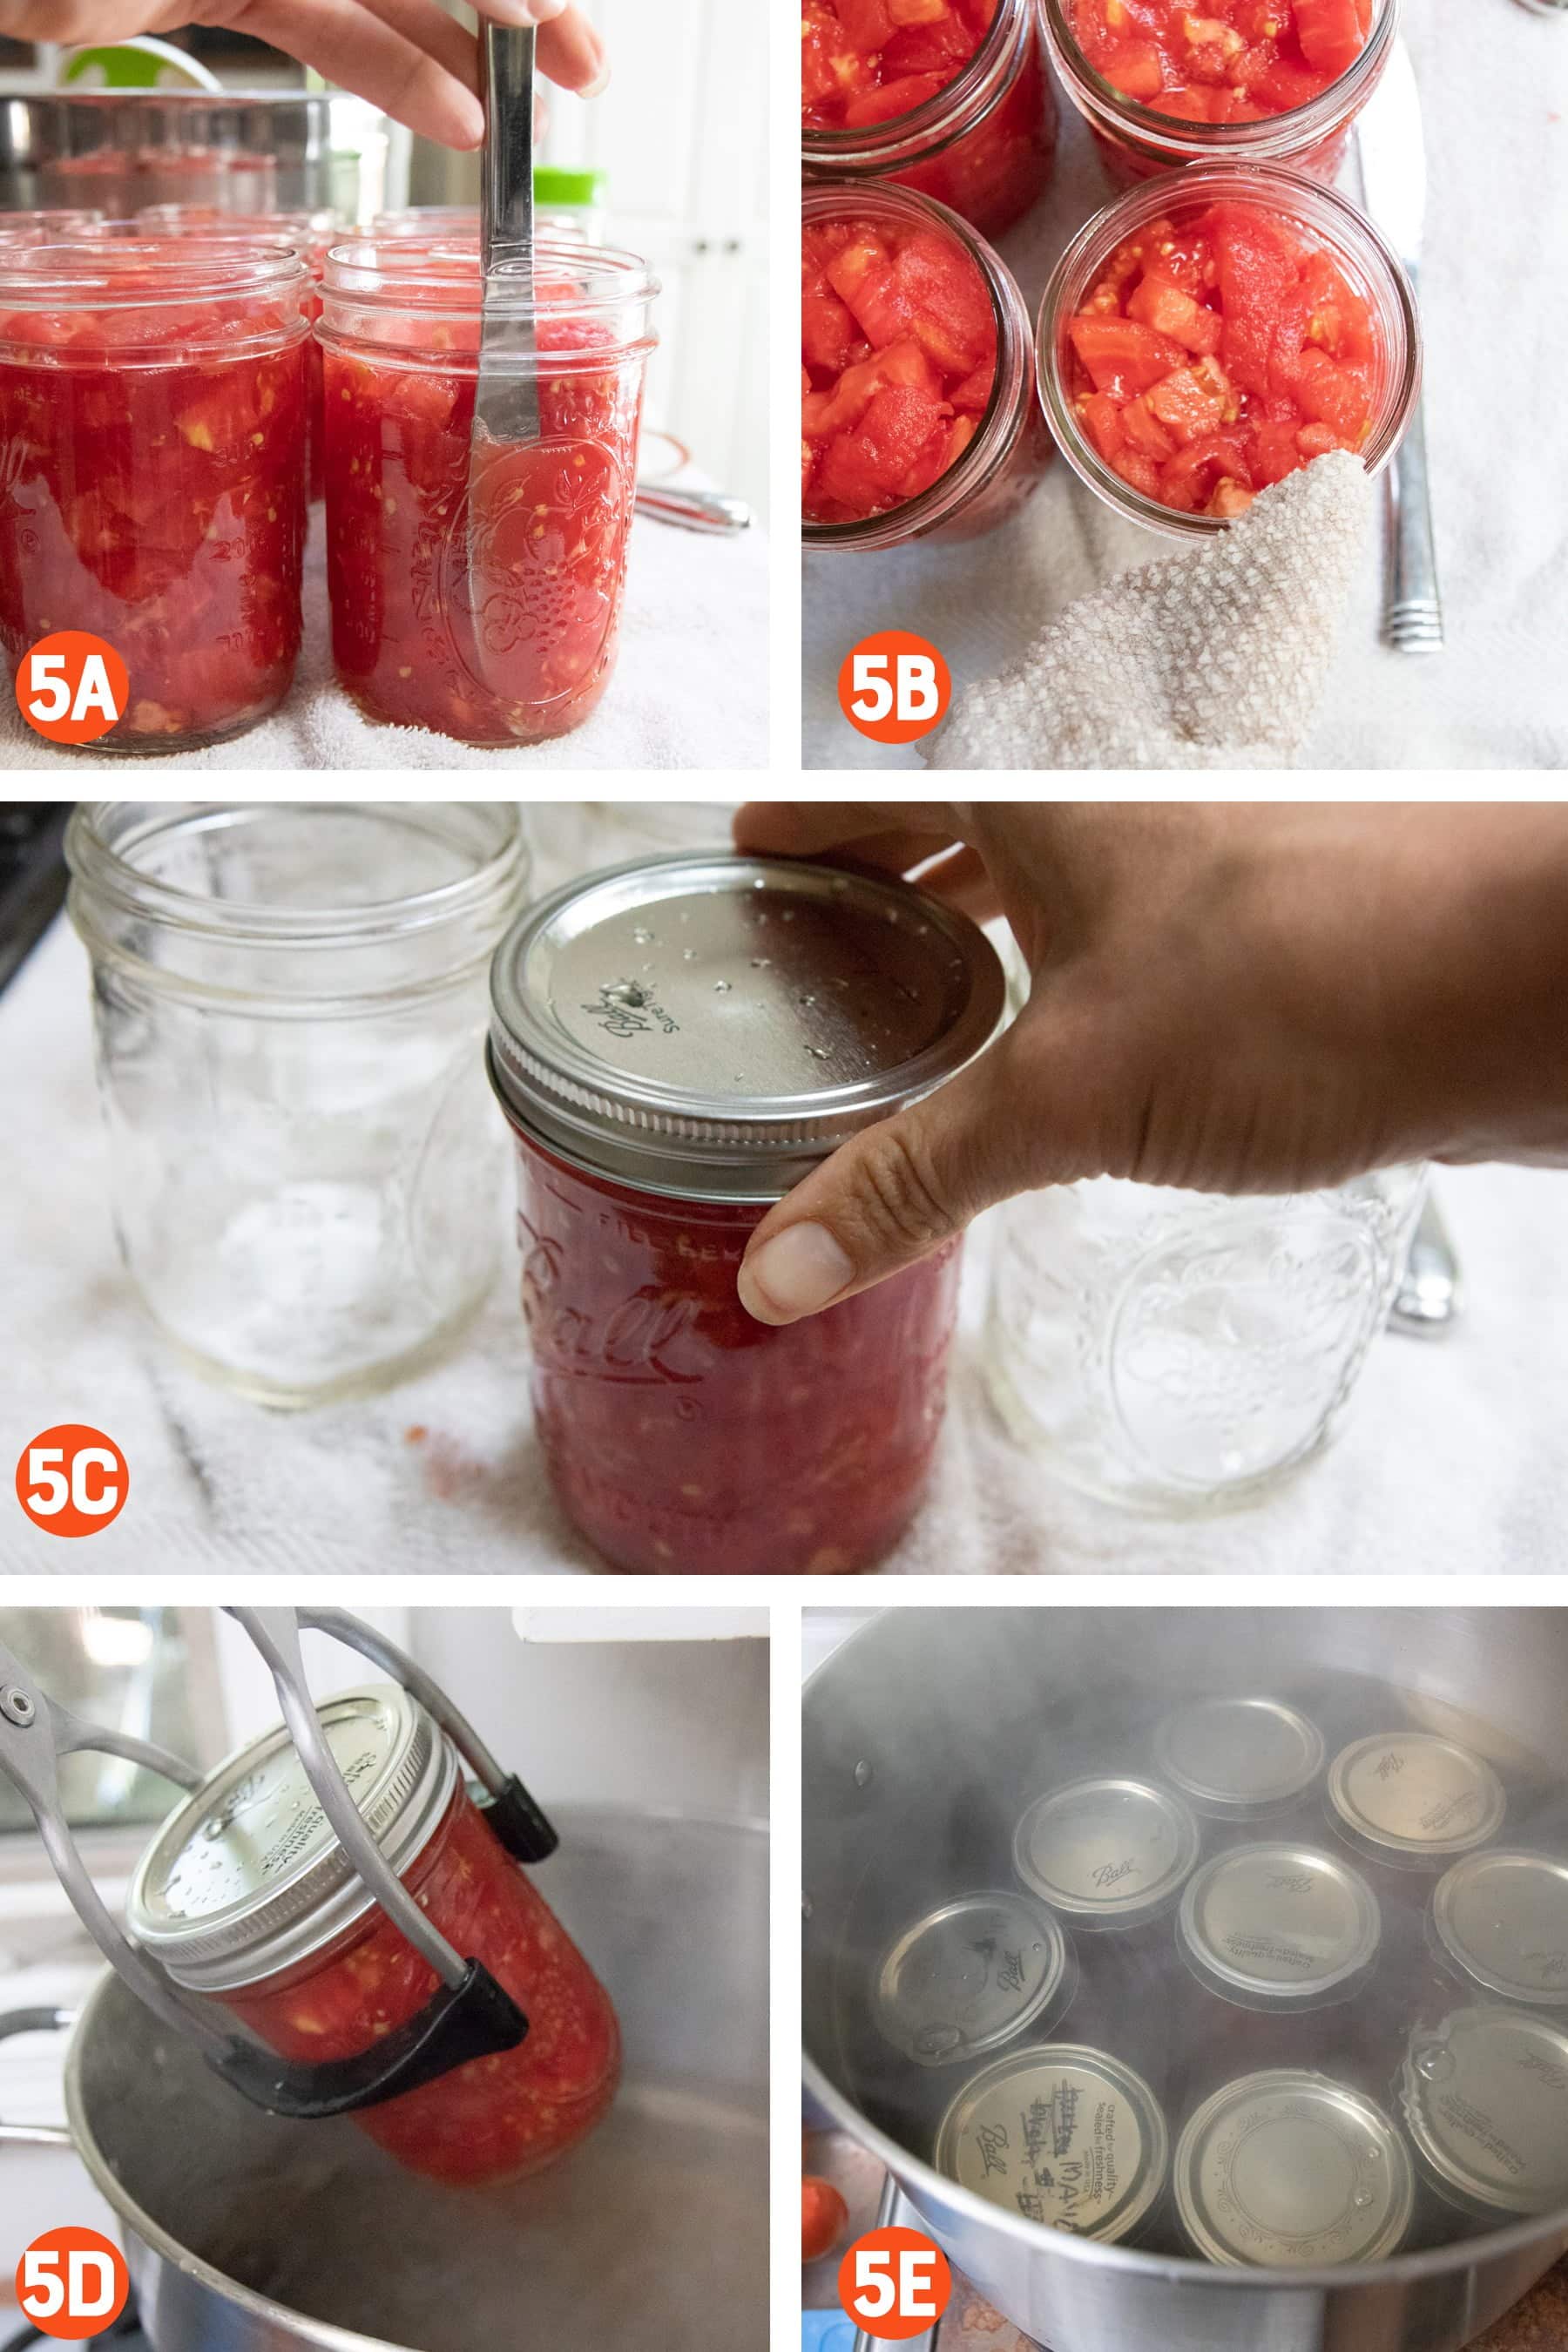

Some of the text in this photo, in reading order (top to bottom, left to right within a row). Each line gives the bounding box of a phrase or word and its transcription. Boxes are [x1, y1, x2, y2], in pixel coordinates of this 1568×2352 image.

[520, 1220, 706, 1385] Ball
[1092, 1857, 1143, 1889] Ball
[997, 1950, 1025, 1992] Ball
[1105, 2104, 1116, 2141] crafted
[977, 2124, 1010, 2176] Ball
[1093, 2146, 1106, 2200] freshness
[1104, 2153, 1119, 2194] quality
